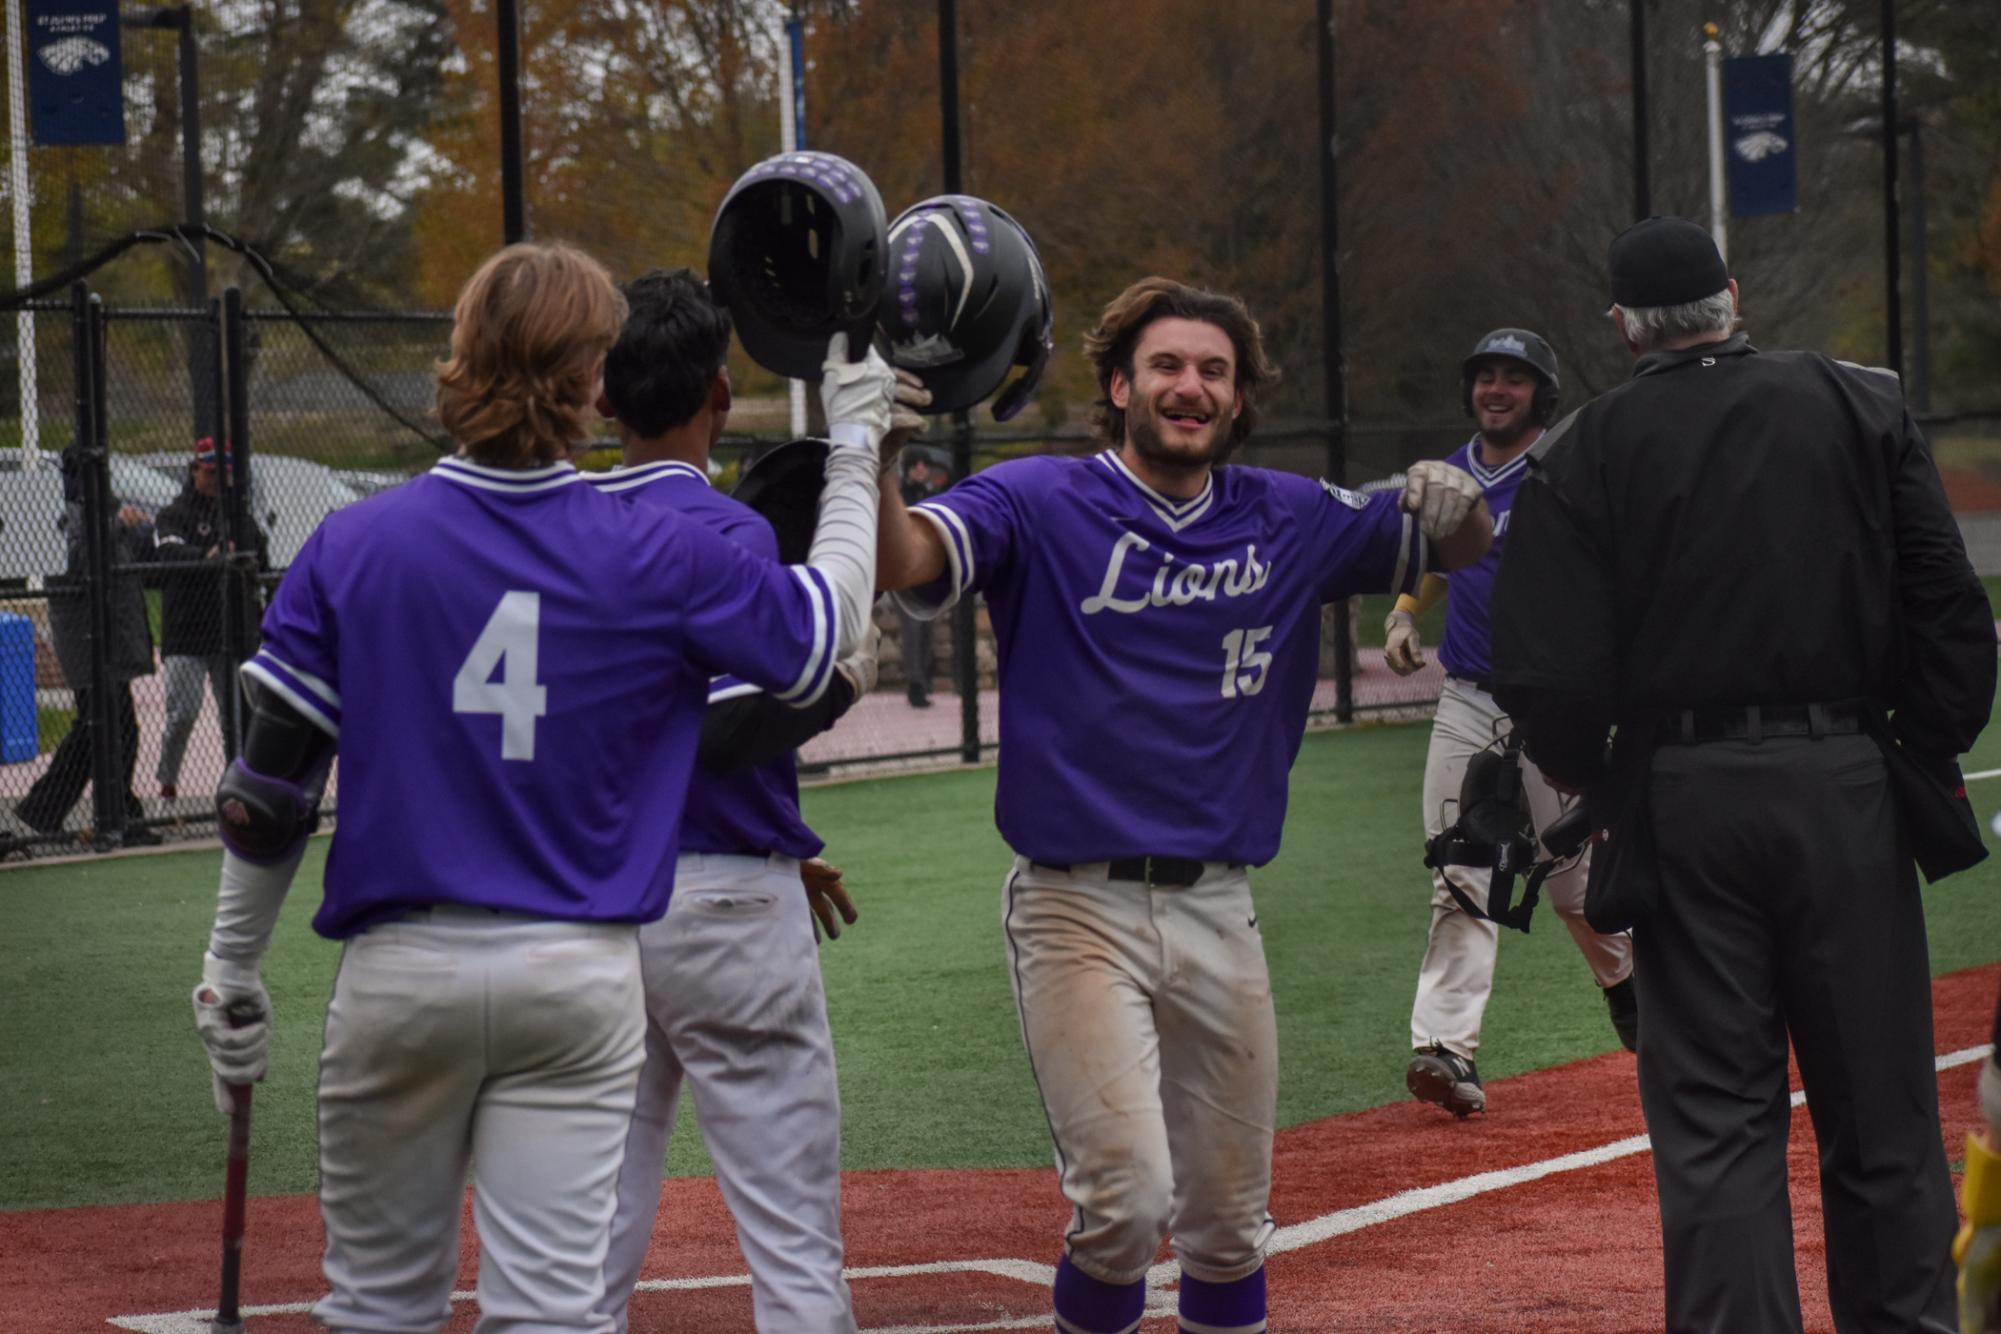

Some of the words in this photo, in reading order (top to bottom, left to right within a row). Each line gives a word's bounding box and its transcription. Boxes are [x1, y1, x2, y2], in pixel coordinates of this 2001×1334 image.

[1080, 531, 1271, 615] Lions
[452, 590, 547, 762] 4
[1221, 624, 1274, 698] 15
